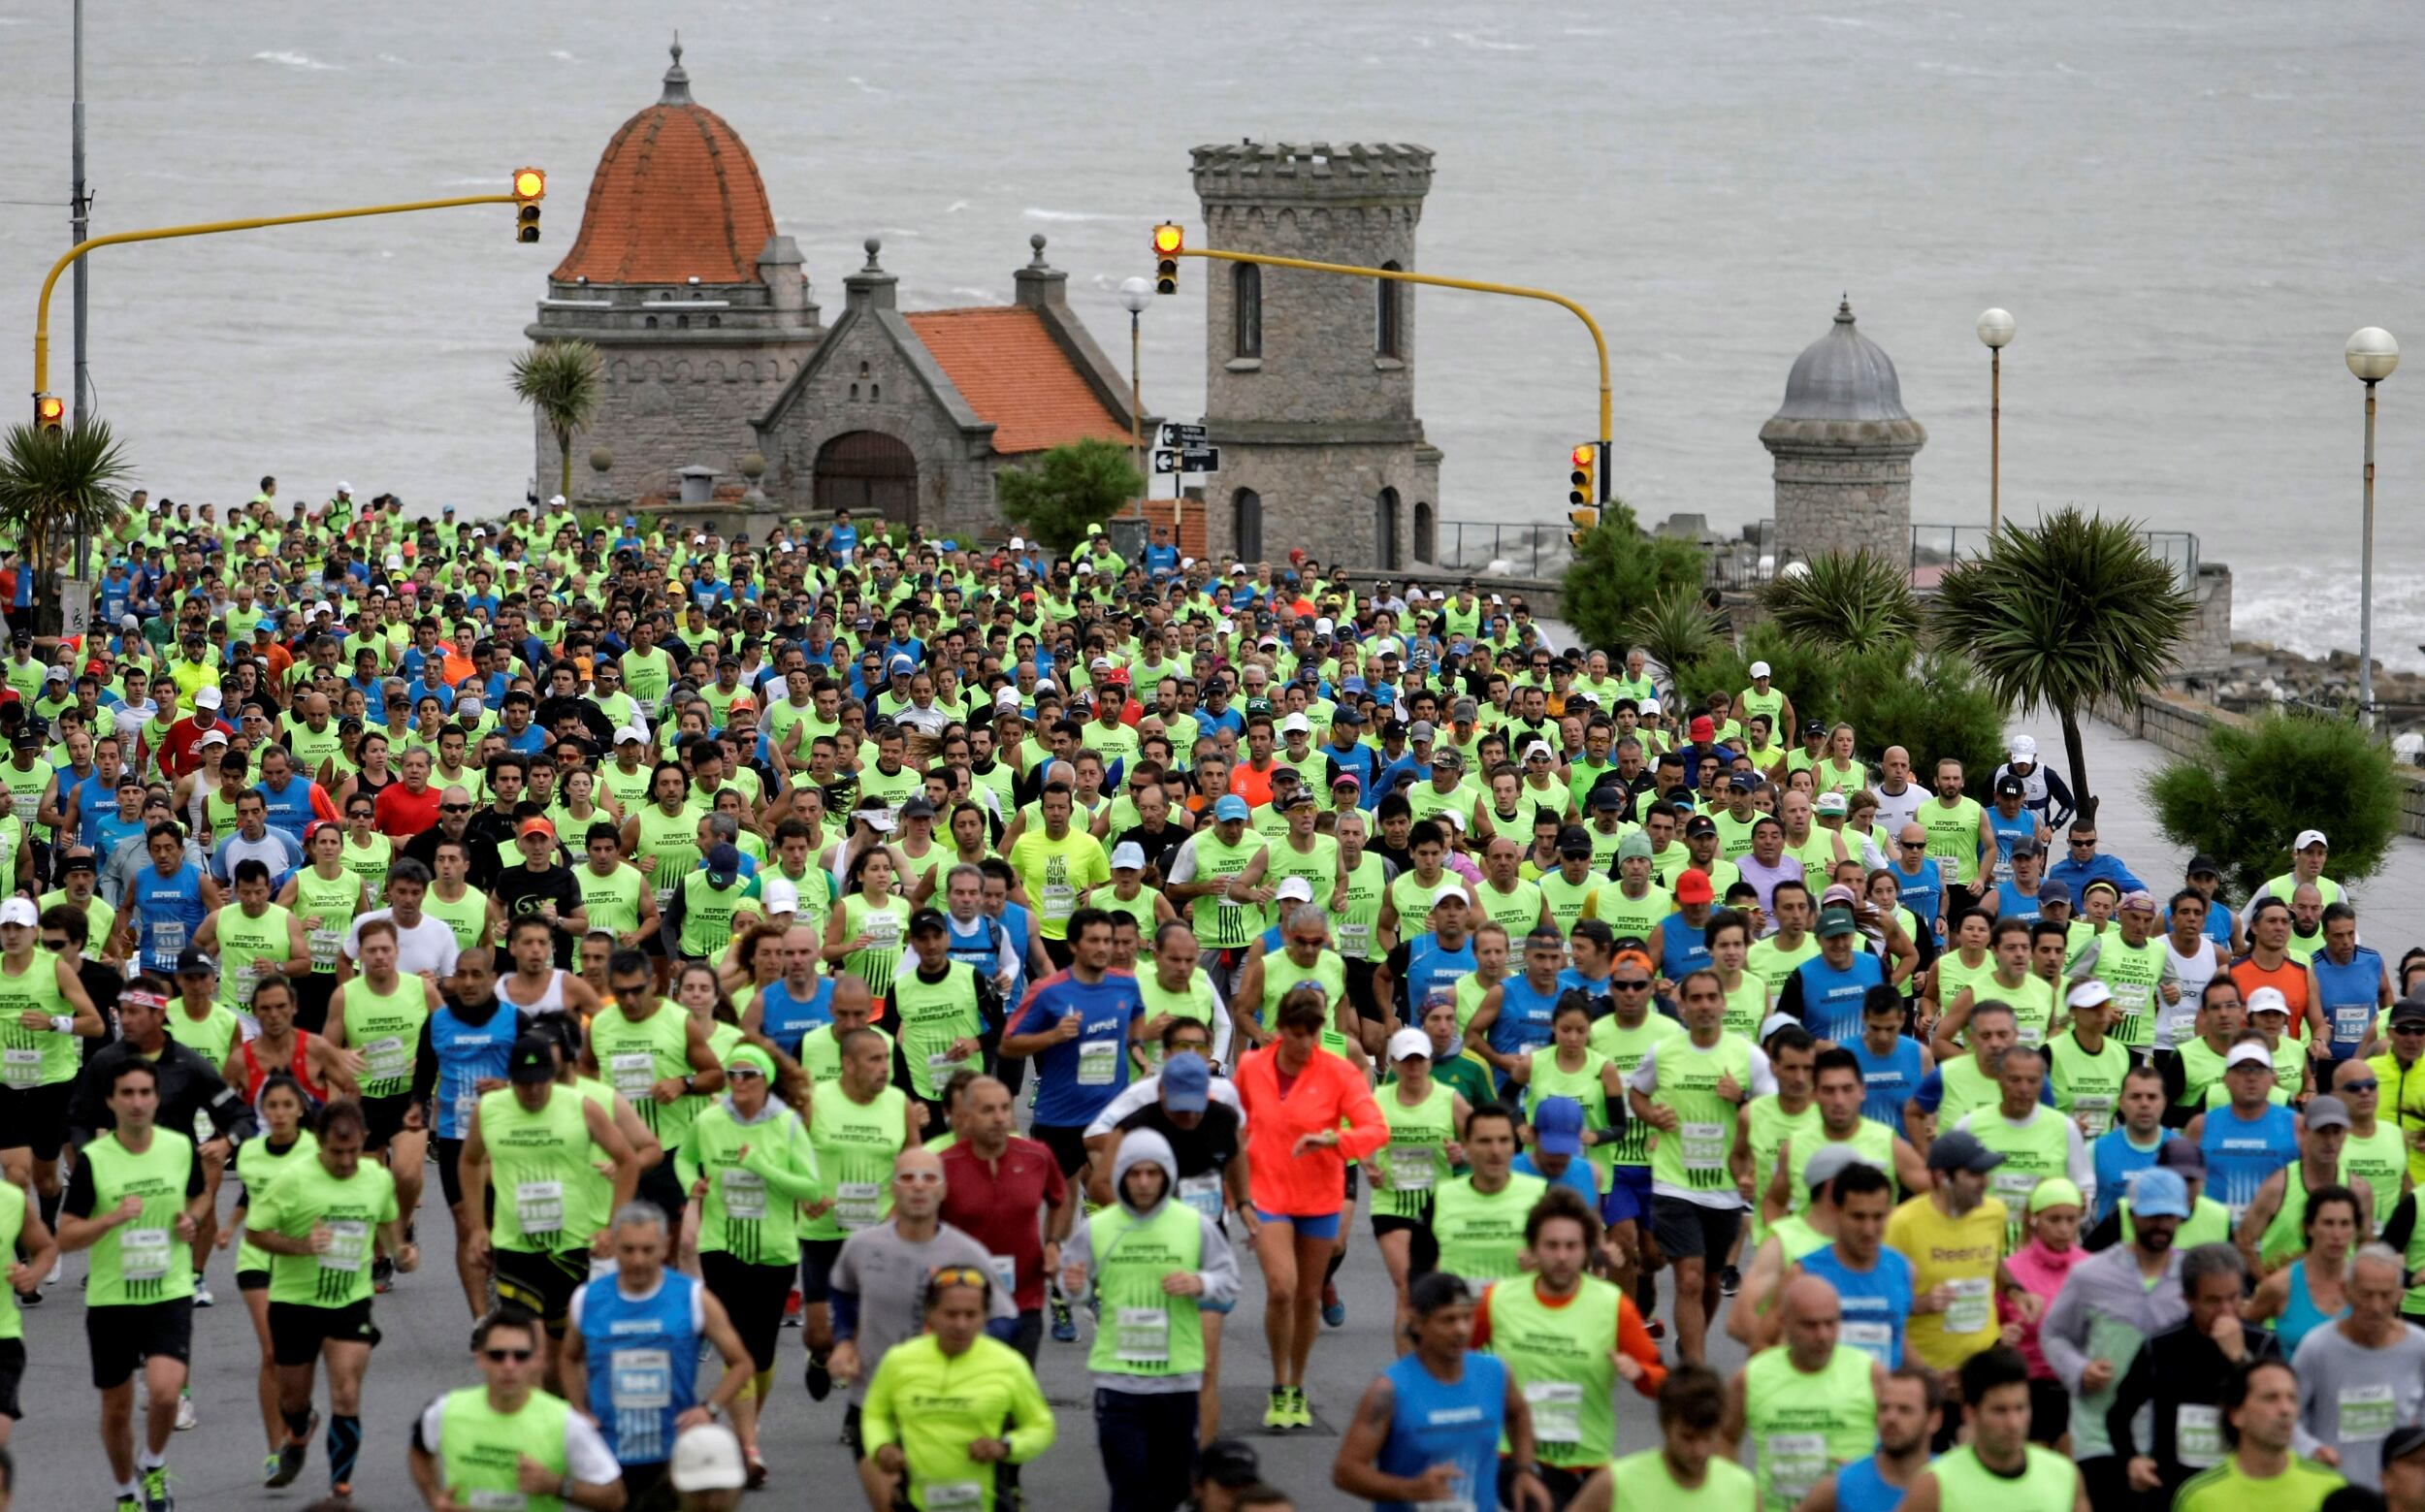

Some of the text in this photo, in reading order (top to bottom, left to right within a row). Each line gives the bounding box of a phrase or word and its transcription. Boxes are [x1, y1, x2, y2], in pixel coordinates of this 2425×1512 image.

[1049, 855, 1064, 865] WE
[1047, 866, 1066, 875] RUN
[1610, 923, 1656, 932] MARDELPLAT
[1828, 985, 1864, 997] DEPORTE
[919, 1004, 954, 1013] DEPORTE
[2343, 1023, 2363, 1034] 184
[454, 1035, 492, 1044] DEPORTE
[2078, 1078, 2110, 1086] DEPORTE
[842, 1125, 882, 1134] DEPORTE
